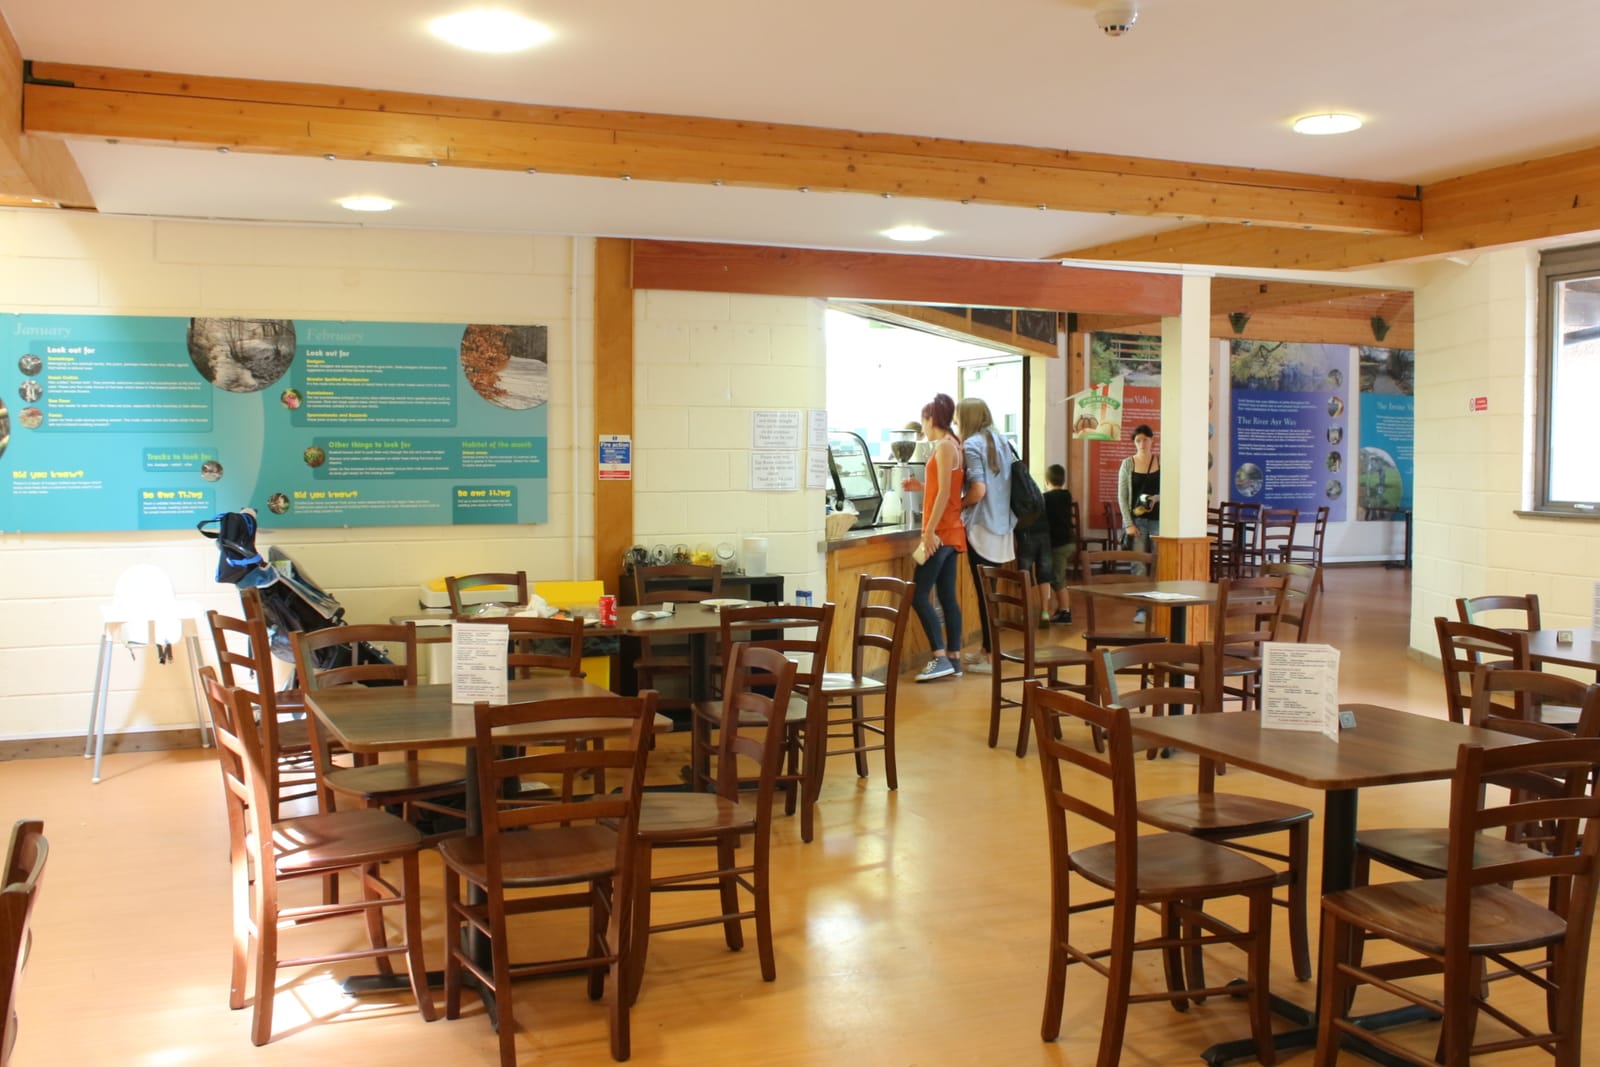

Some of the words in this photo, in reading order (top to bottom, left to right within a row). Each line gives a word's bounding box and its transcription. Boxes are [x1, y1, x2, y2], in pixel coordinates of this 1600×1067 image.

[14, 322, 72, 338] January
[306, 327, 364, 344] February
[47, 346, 67, 354] Look
[83, 346, 96, 355] for
[306, 349, 323, 357] Look
[339, 349, 350, 359] for
[1237, 416, 1251, 425] The
[1252, 417, 1269, 425] River
[328, 441, 349, 449] Other
[351, 441, 373, 450] things
[384, 441, 399, 449] look
[400, 441, 411, 450] for
[462, 441, 488, 449] Habitat
